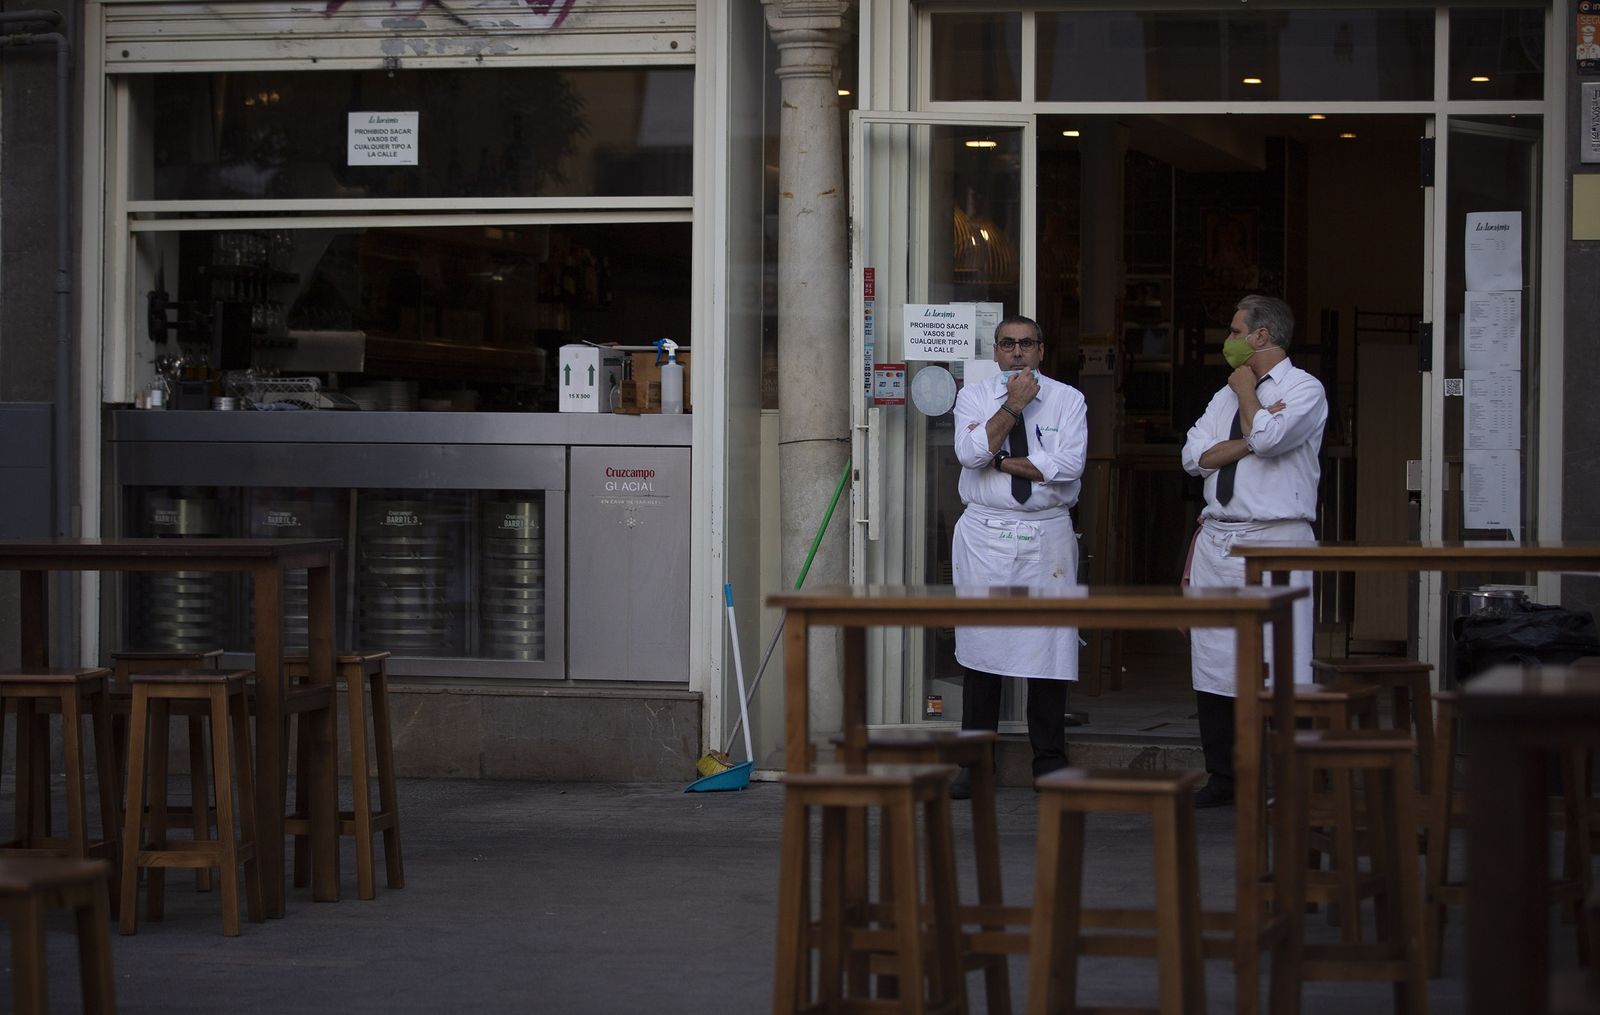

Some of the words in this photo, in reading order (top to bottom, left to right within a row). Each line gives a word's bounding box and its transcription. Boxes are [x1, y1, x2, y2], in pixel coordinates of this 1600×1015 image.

[910, 321, 945, 330] PROHIBIDO
[946, 322, 969, 330] SACAR
[922, 330, 945, 338] VASOS
[910, 338, 947, 346] CUALQUIER
[933, 346, 955, 354] CALLE
[605, 466, 656, 480] Cruzcampo
[605, 481, 655, 492] GLACIAL
